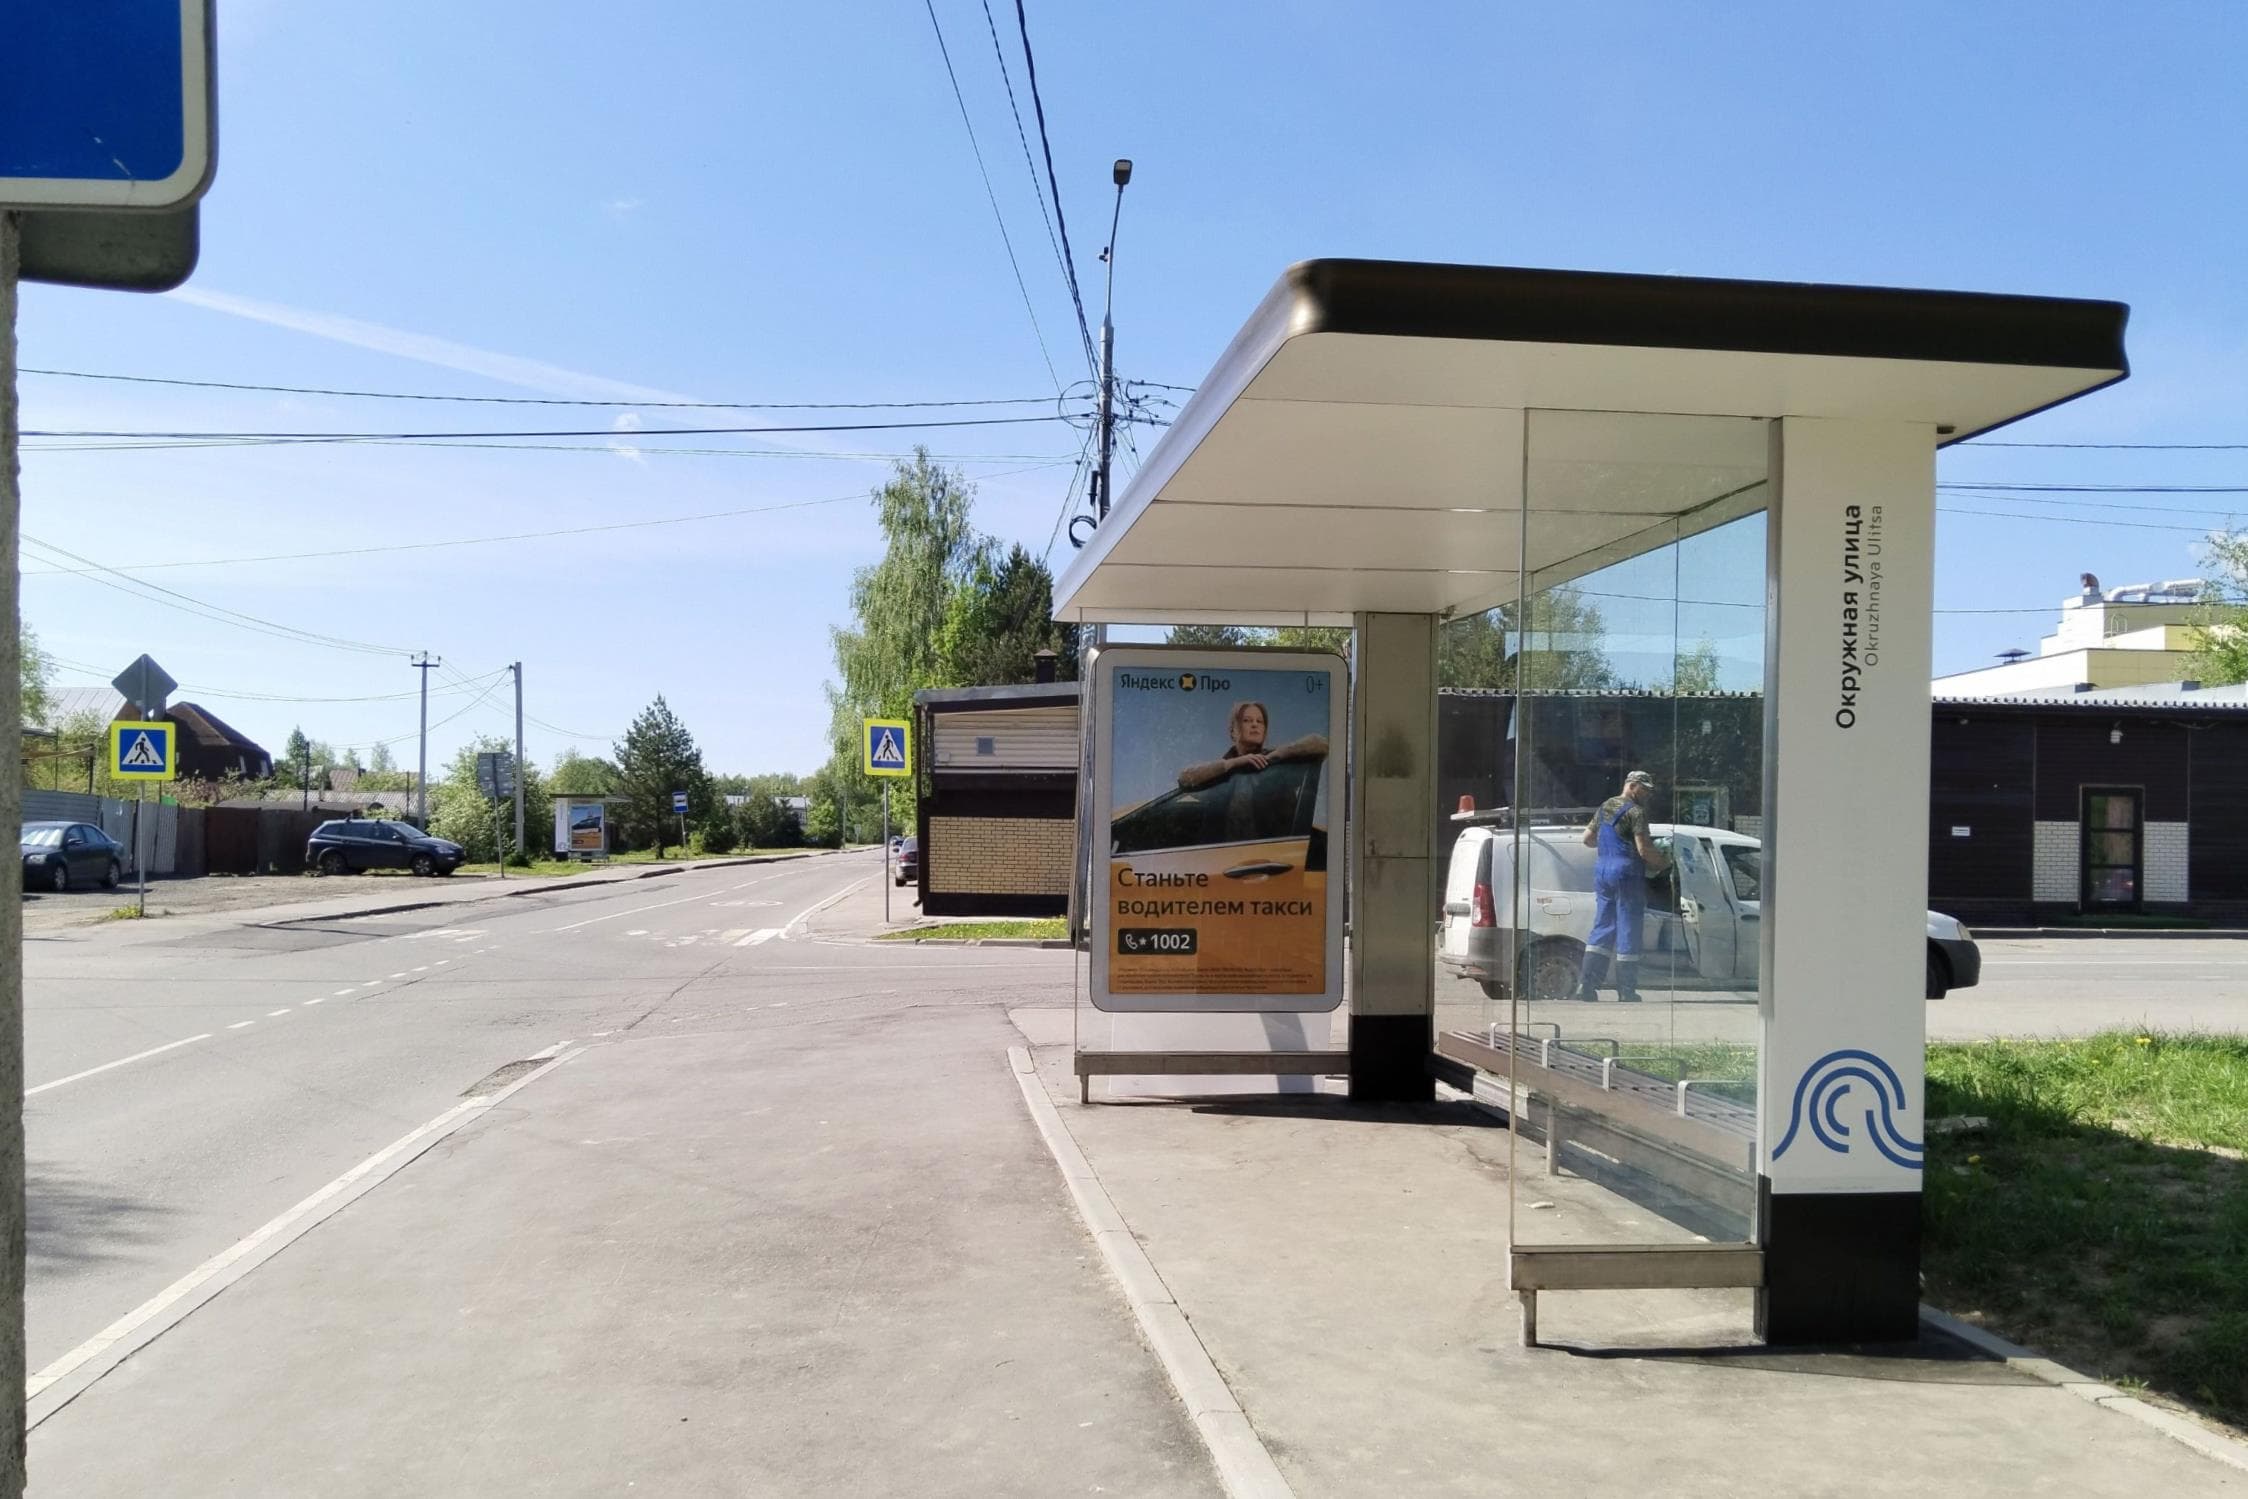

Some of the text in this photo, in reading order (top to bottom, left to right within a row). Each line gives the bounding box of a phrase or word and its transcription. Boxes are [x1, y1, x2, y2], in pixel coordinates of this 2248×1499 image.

[1864, 505, 1884, 667] Okruzhnaya Ulitsa
[1836, 505, 1864, 729] Окружная улица
[1120, 674, 1231, 695] Яндекс Про
[1306, 675, 1324, 694] 0+
[1117, 867, 1209, 888] Станьте
[1117, 899, 1313, 919] водителем такси
